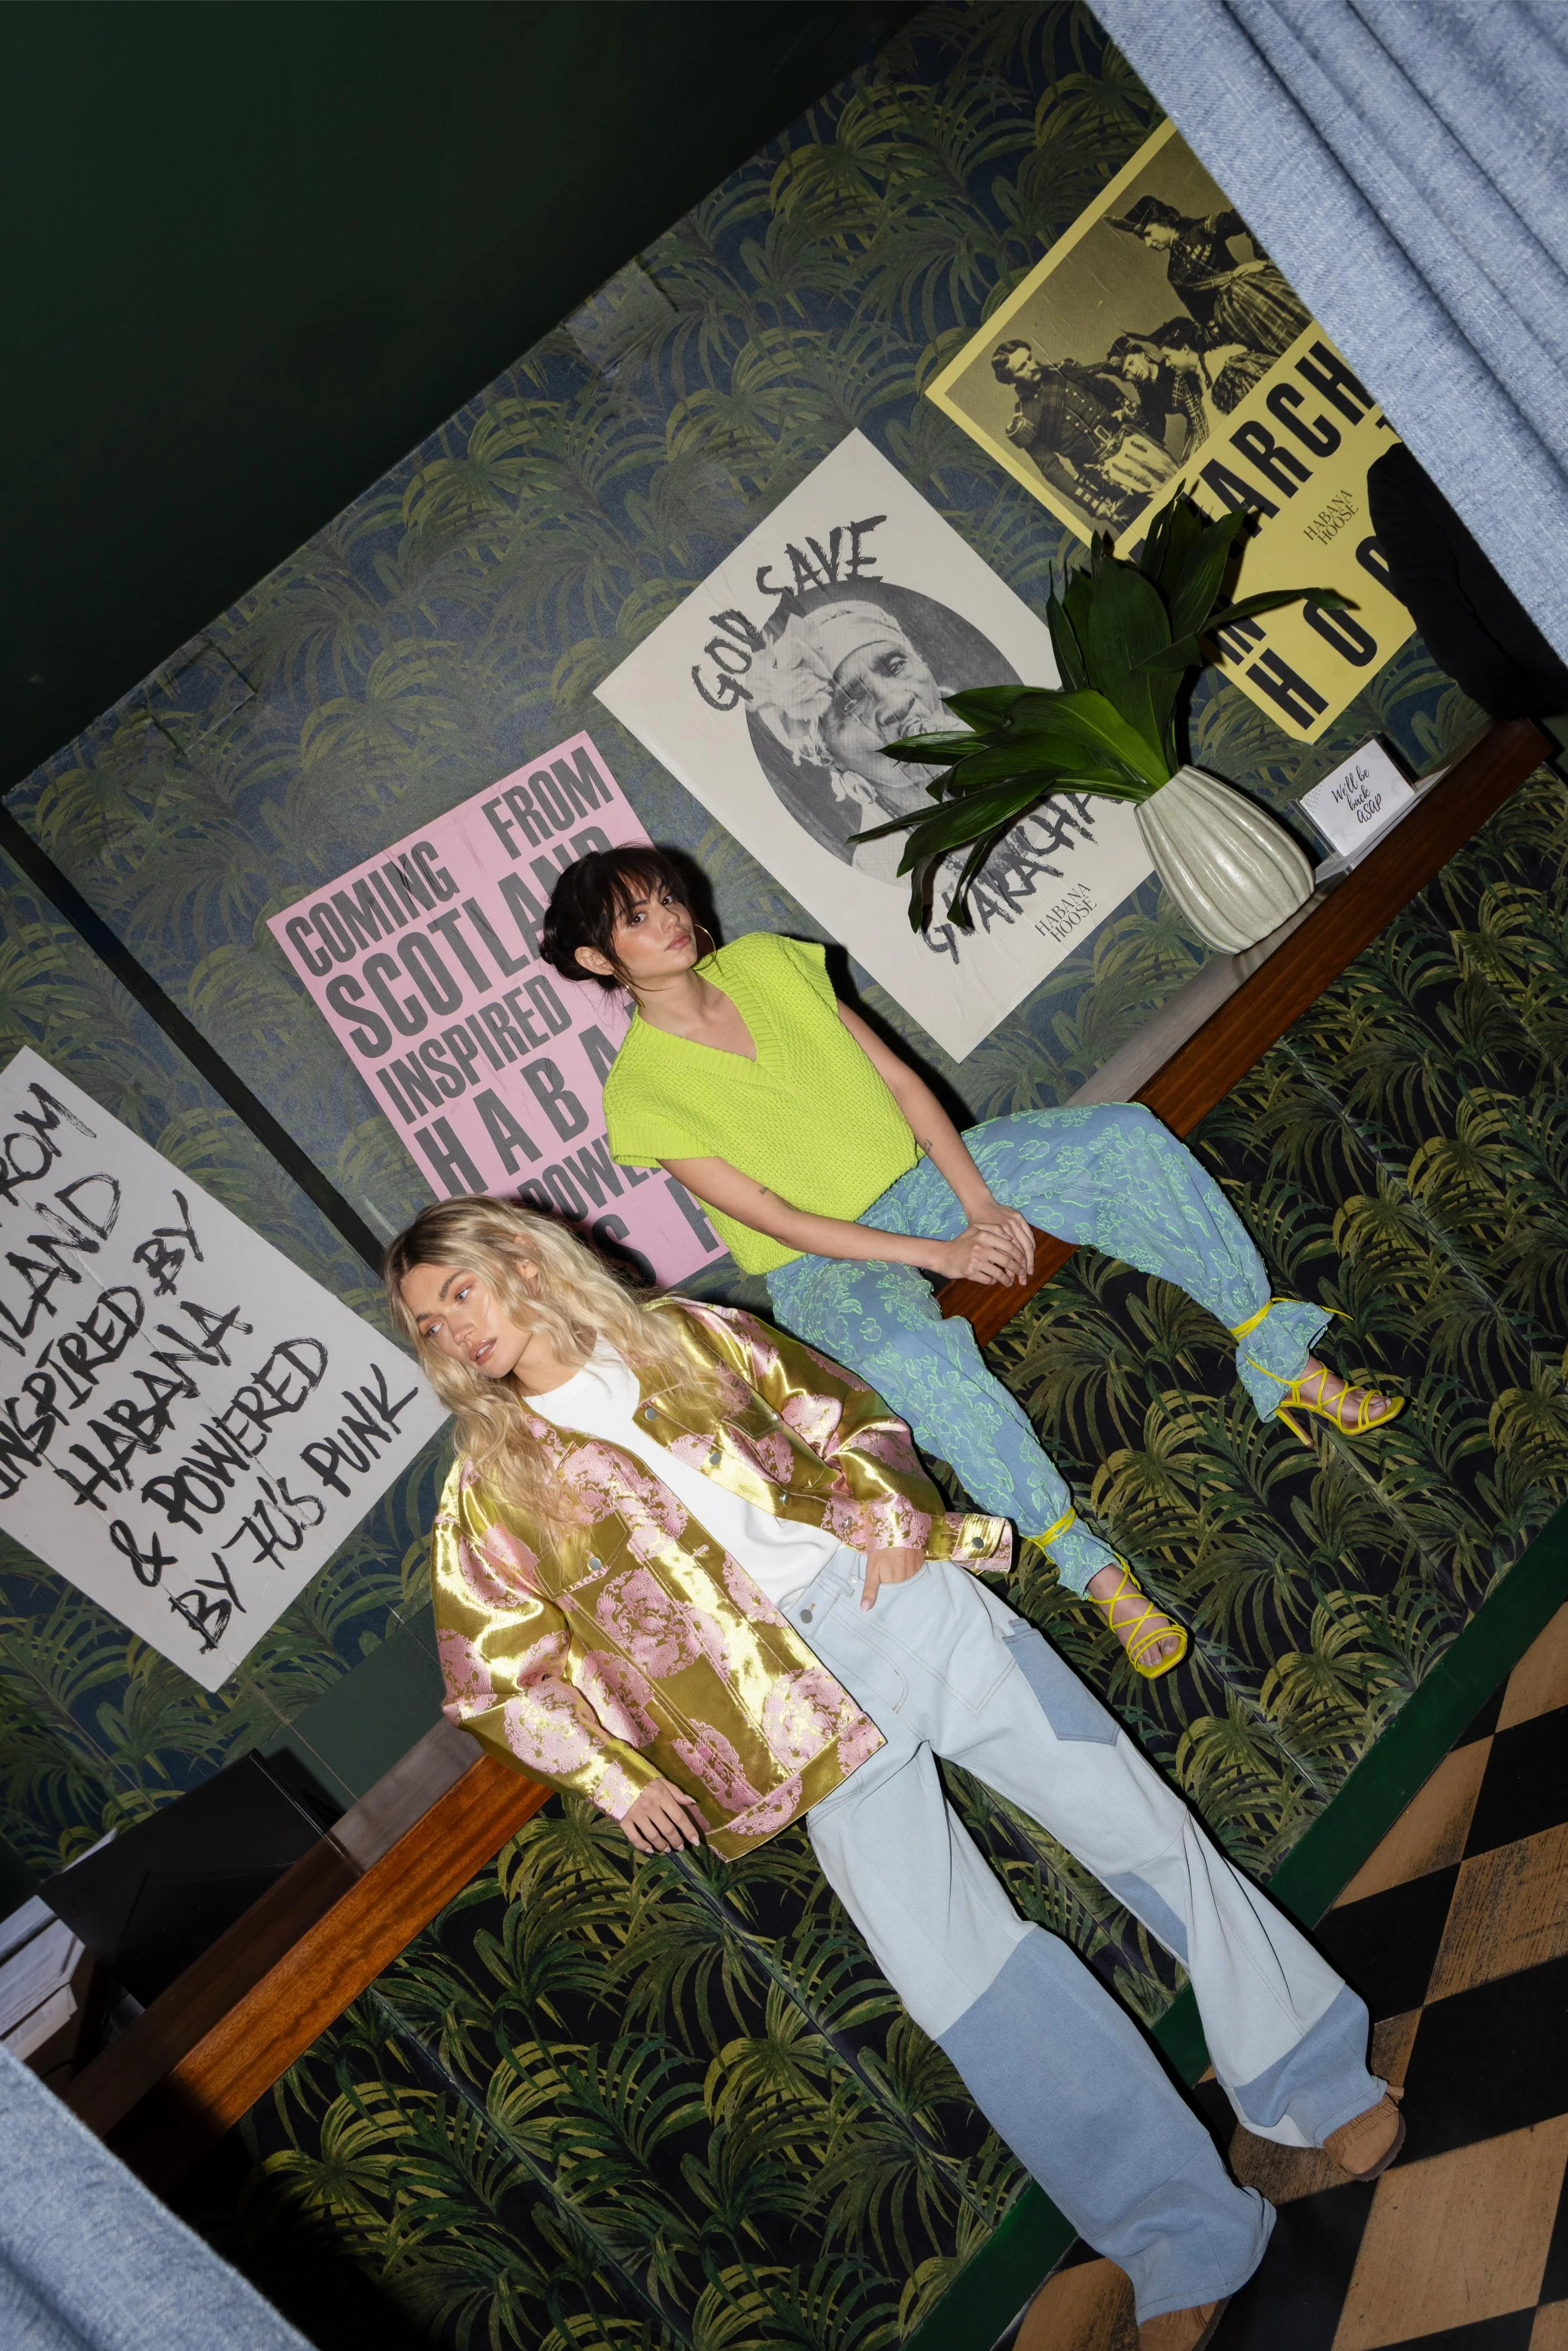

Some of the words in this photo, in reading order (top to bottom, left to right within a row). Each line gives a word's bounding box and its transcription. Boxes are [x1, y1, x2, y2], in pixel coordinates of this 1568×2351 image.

[1129, 341, 1377, 566] ARCH
[1304, 490, 1352, 540] HABANA
[1317, 501, 1359, 545] HOOSE
[692, 609, 766, 711] GOD
[756, 514, 887, 618] SAVE
[1331, 772, 1357, 803] We'll
[1356, 765, 1369, 782] be
[1347, 784, 1371, 811] back
[285, 841, 459, 977] COMING
[481, 745, 614, 861] FROM
[1034, 882, 1092, 937] HABANA
[1049, 896, 1098, 943] HOOSE
[325, 826, 615, 1059] SCOTLA
[376, 974, 572, 1125] INSPIRED
[0, 1172, 121, 1356] LAND
[132, 1189, 206, 1297] BY
[54, 1301, 253, 1511] HABANA
[140, 1337, 328, 1535] POWERED
[110, 1519, 178, 1587] &
[168, 1552, 247, 1655] BY
[299, 1363, 419, 1498] PUNK
